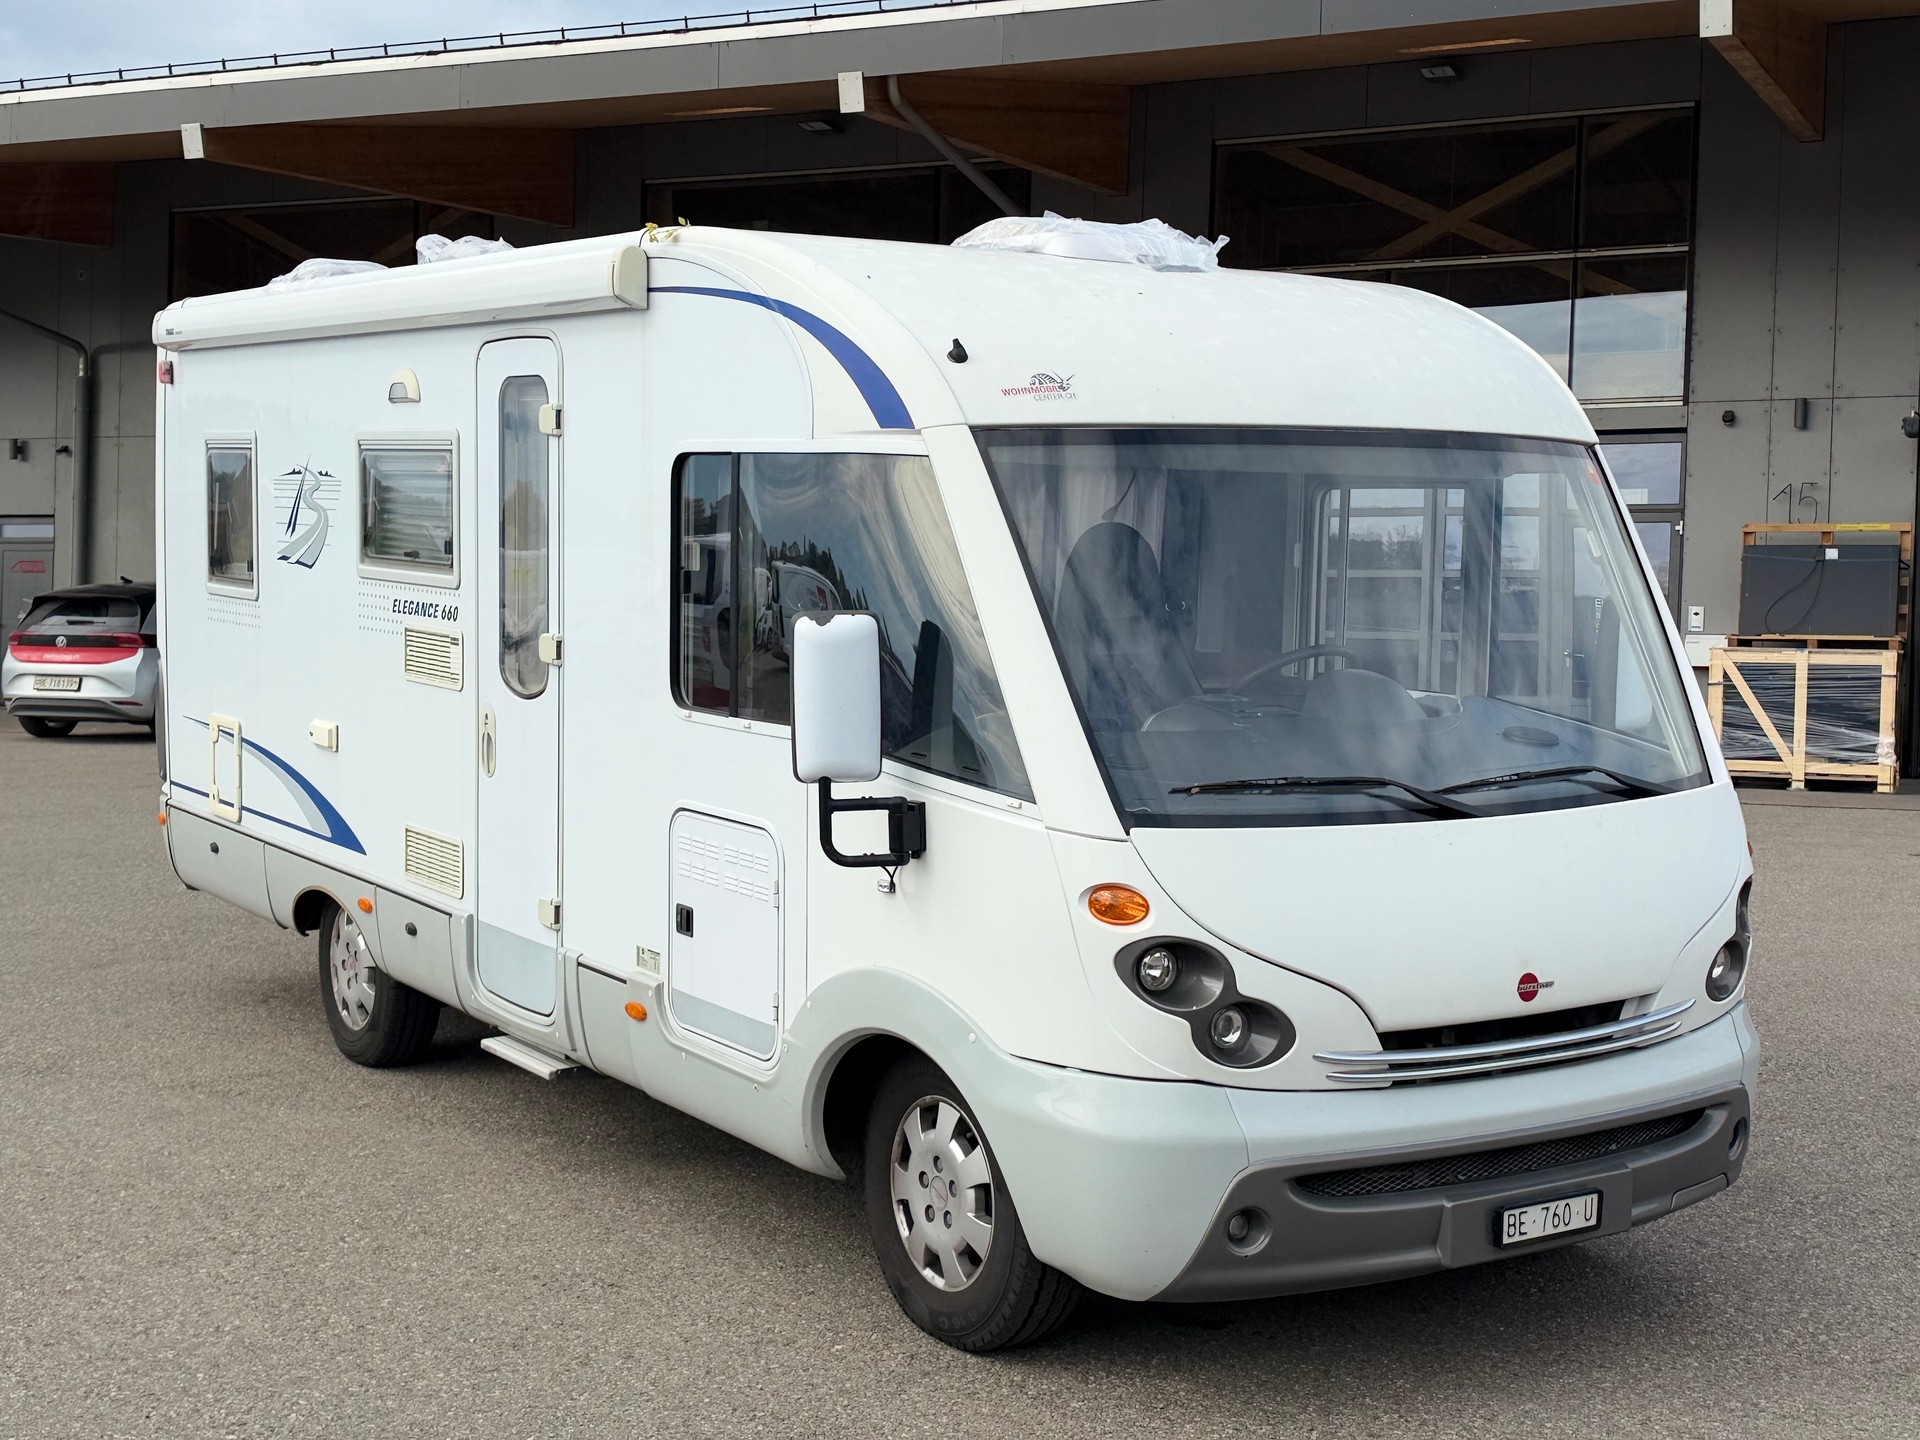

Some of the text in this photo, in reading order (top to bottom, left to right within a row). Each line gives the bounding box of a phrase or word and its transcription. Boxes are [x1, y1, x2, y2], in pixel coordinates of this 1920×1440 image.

[1772, 482, 1819, 524] 15
[392, 598, 459, 622] ELEGANCE 660
[1507, 1197, 1594, 1238] BE 760 U
